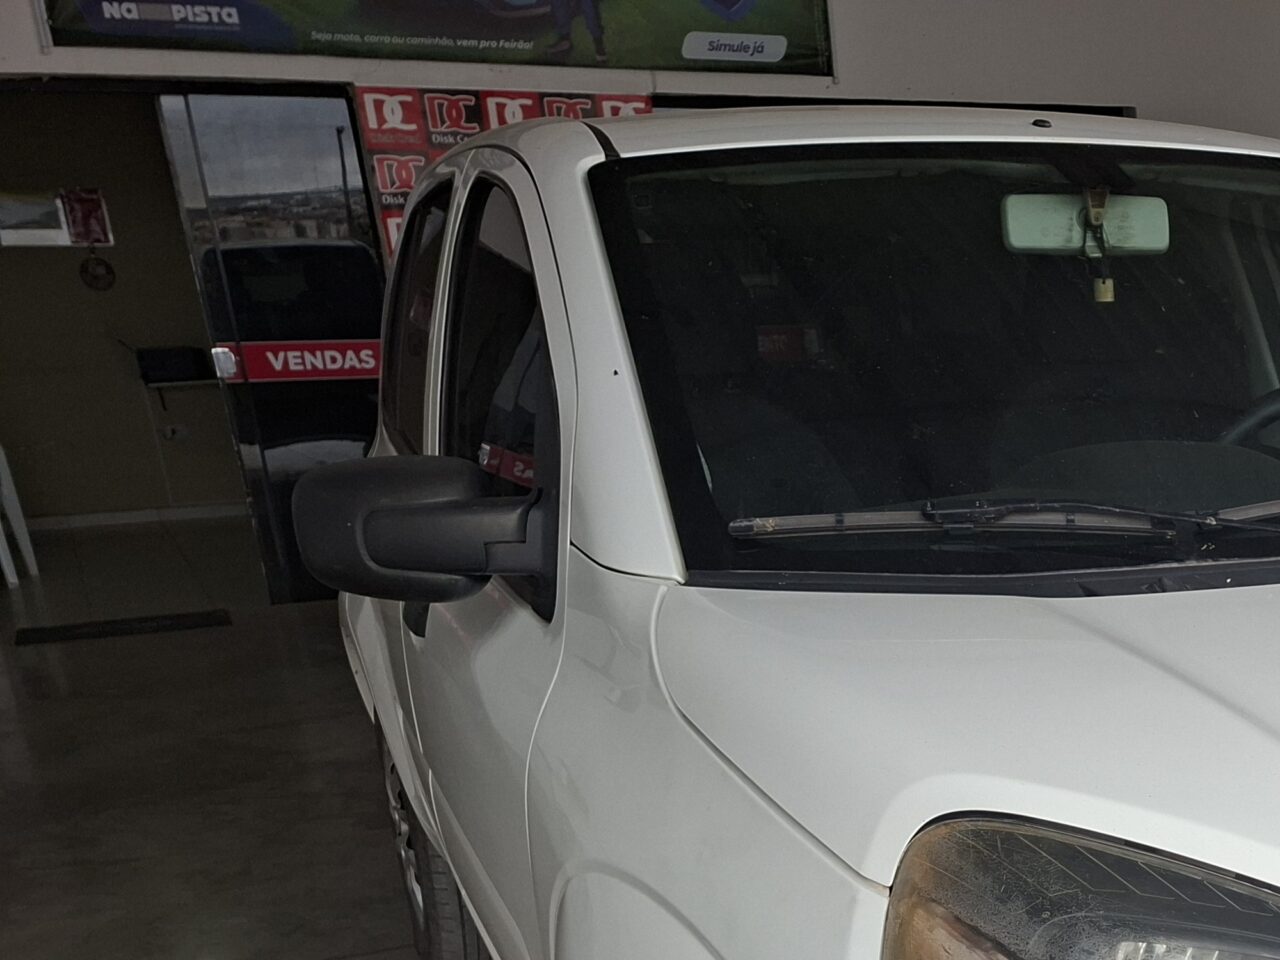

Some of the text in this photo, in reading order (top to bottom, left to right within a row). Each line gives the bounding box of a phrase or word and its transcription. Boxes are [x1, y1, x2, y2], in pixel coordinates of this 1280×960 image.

[311, 31, 332, 42] Seja
[392, 36, 404, 44] ou
[456, 39, 478, 47] vem
[479, 39, 498, 49] pro
[707, 40, 765, 56] Simule já
[431, 134, 456, 144] Disk
[382, 195, 405, 204] Disk
[266, 349, 377, 371] VENDAS
